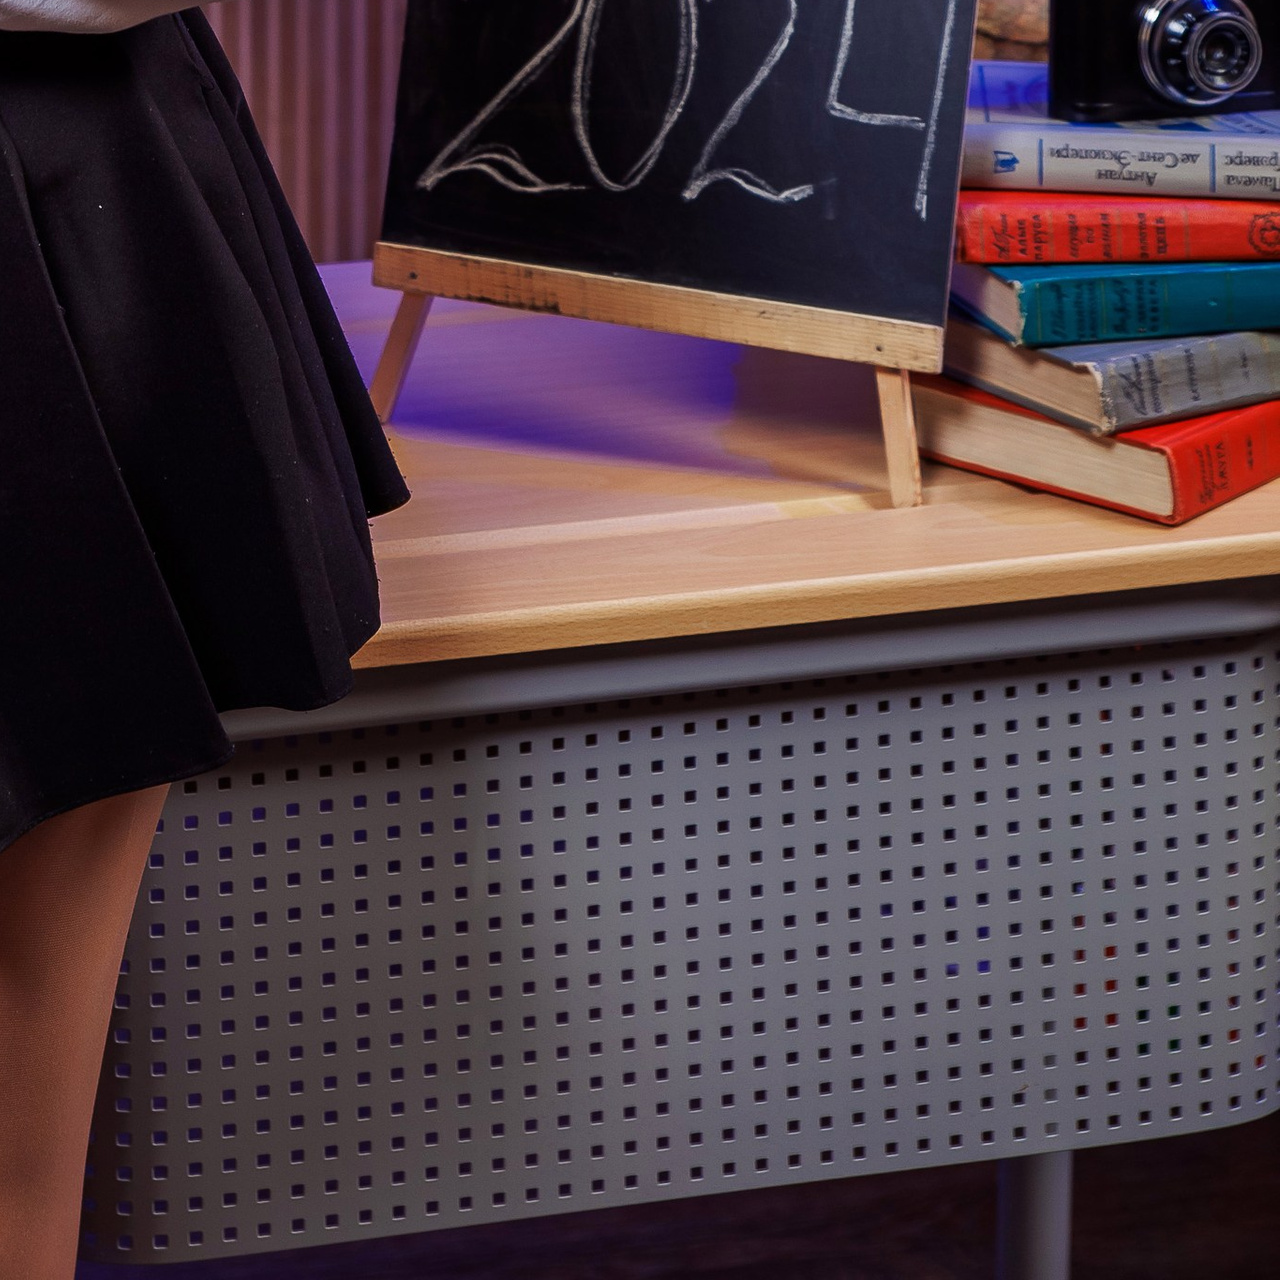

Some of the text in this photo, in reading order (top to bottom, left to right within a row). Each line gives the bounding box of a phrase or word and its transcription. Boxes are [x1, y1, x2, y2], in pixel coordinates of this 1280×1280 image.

[1048, 144, 1179, 169] Сент-Экзюпери
[1095, 165, 1157, 187] Антуан
[1017, 219, 1029, 257] АЛЫЕ
[1031, 214, 1047, 261] ПАРУСА
[1155, 217, 1169, 255] ЦЕПЬ
